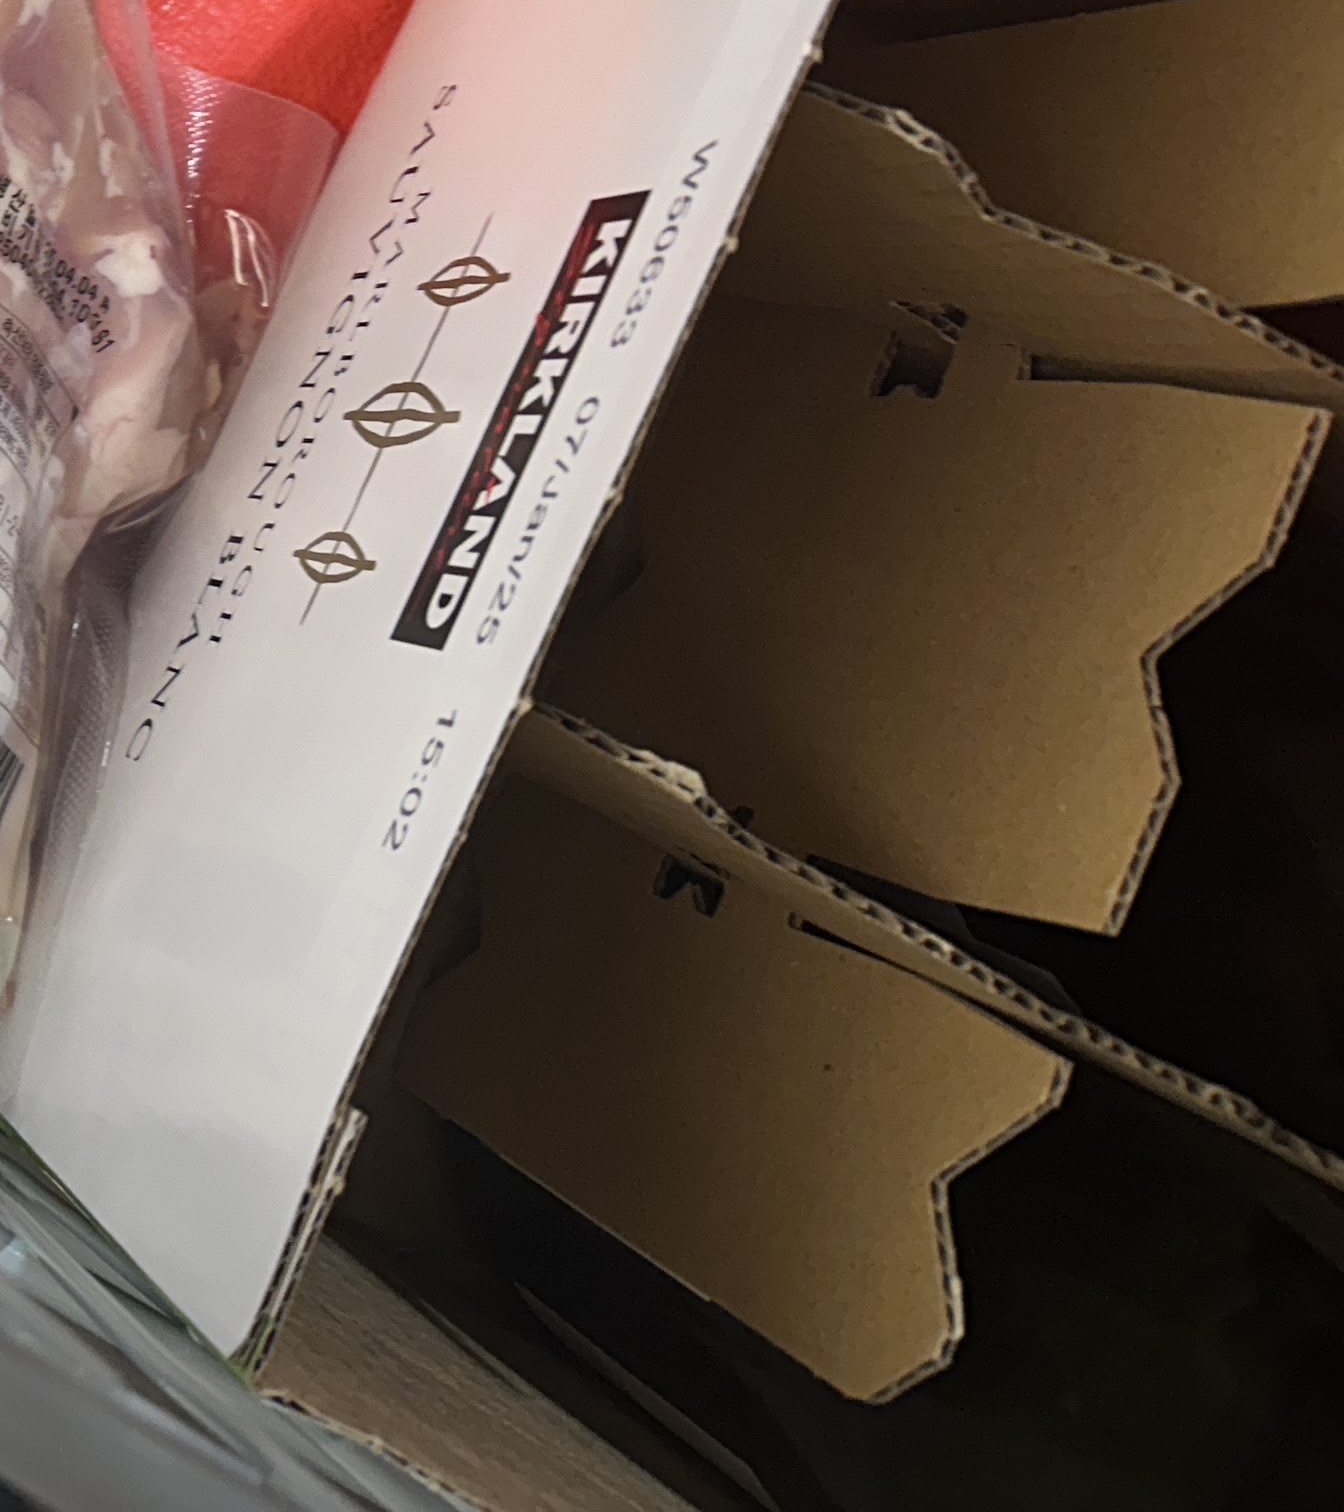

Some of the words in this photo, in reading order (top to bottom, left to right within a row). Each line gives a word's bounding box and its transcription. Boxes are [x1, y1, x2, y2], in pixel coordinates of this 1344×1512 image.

[247, 83, 458, 503] SAUVIGNON
[609, 140, 720, 351] W50633
[206, 185, 435, 647] MARLBOROUGH
[423, 219, 631, 634] KIRKLAND
[475, 395, 601, 648] 07/Jan/25
[124, 529, 247, 763] BLANC
[383, 707, 459, 853] 15:02
